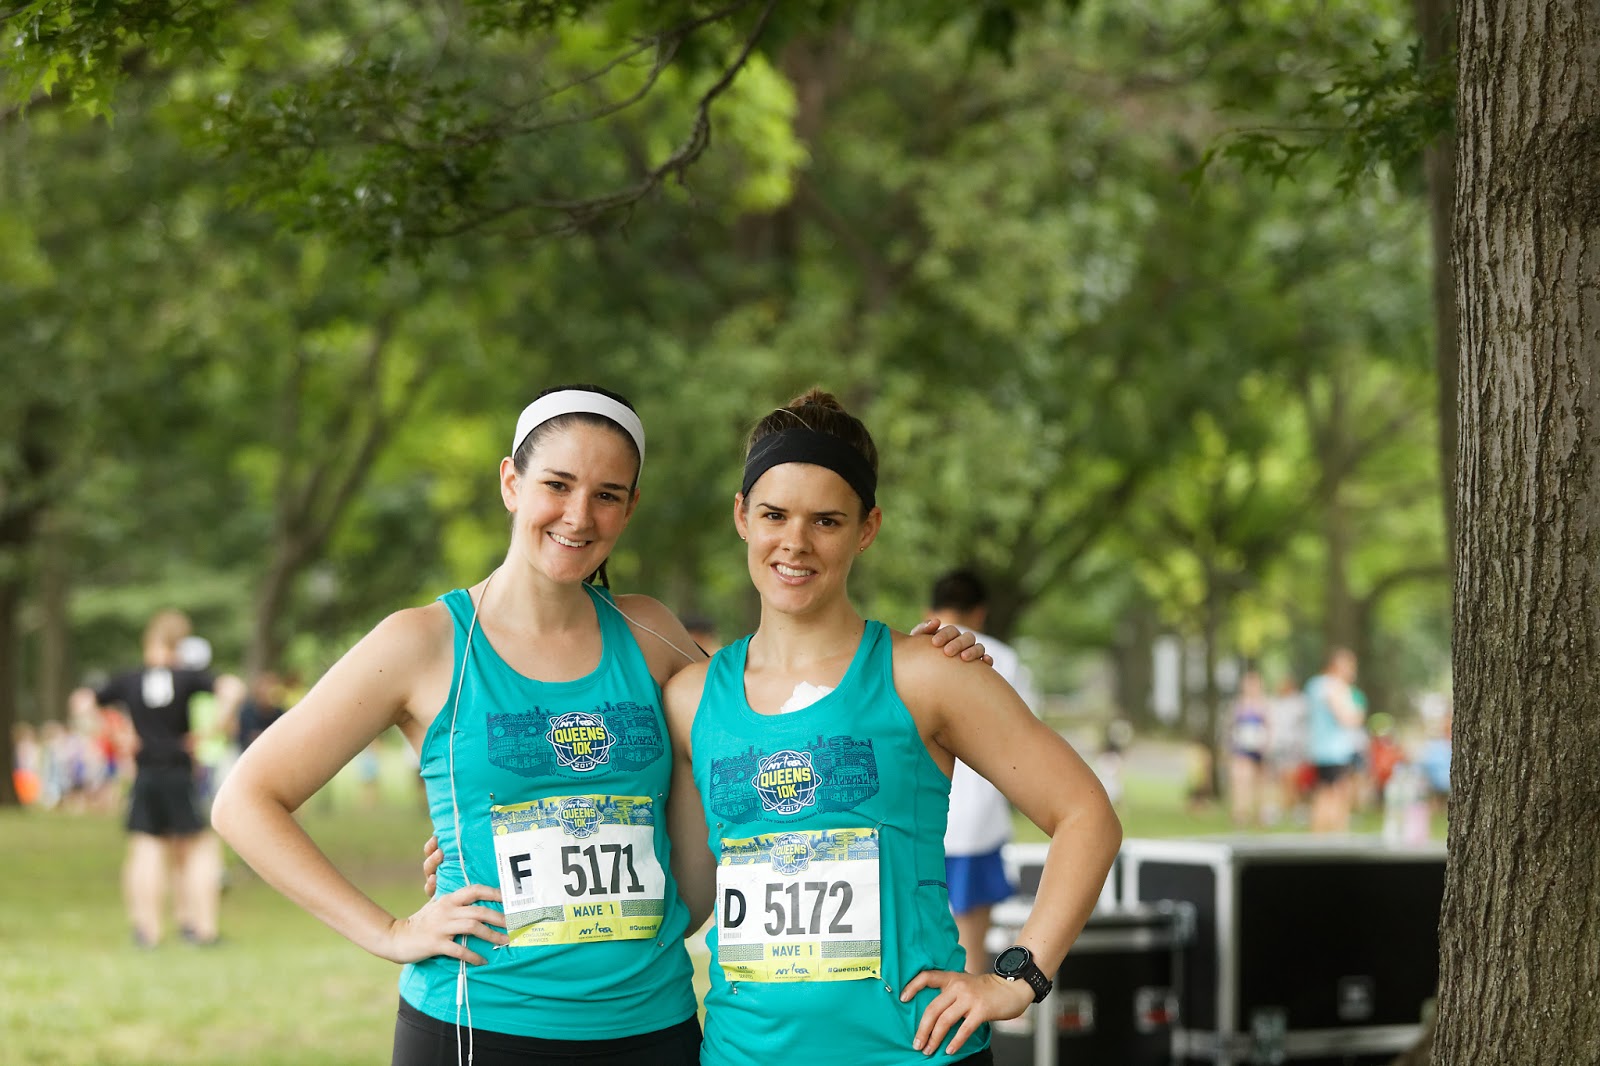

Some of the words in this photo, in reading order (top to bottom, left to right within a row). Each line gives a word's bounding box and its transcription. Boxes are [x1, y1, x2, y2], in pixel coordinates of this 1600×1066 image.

[554, 727, 606, 743] QUEENS
[572, 742, 592, 755] 10K
[760, 767, 811, 787] QUEENS
[776, 784, 798, 798] 10K
[563, 808, 596, 819] QUEENS
[574, 818, 587, 828] 10K
[776, 844, 807, 856] QUEENS
[509, 853, 532, 895] F
[560, 843, 645, 897] 5171
[573, 904, 604, 917] WAVE
[609, 904, 614, 915] 1
[724, 888, 747, 928] D
[764, 880, 853, 936] 5172
[772, 945, 800, 957] WAVE
[808, 945, 813, 955] 1
